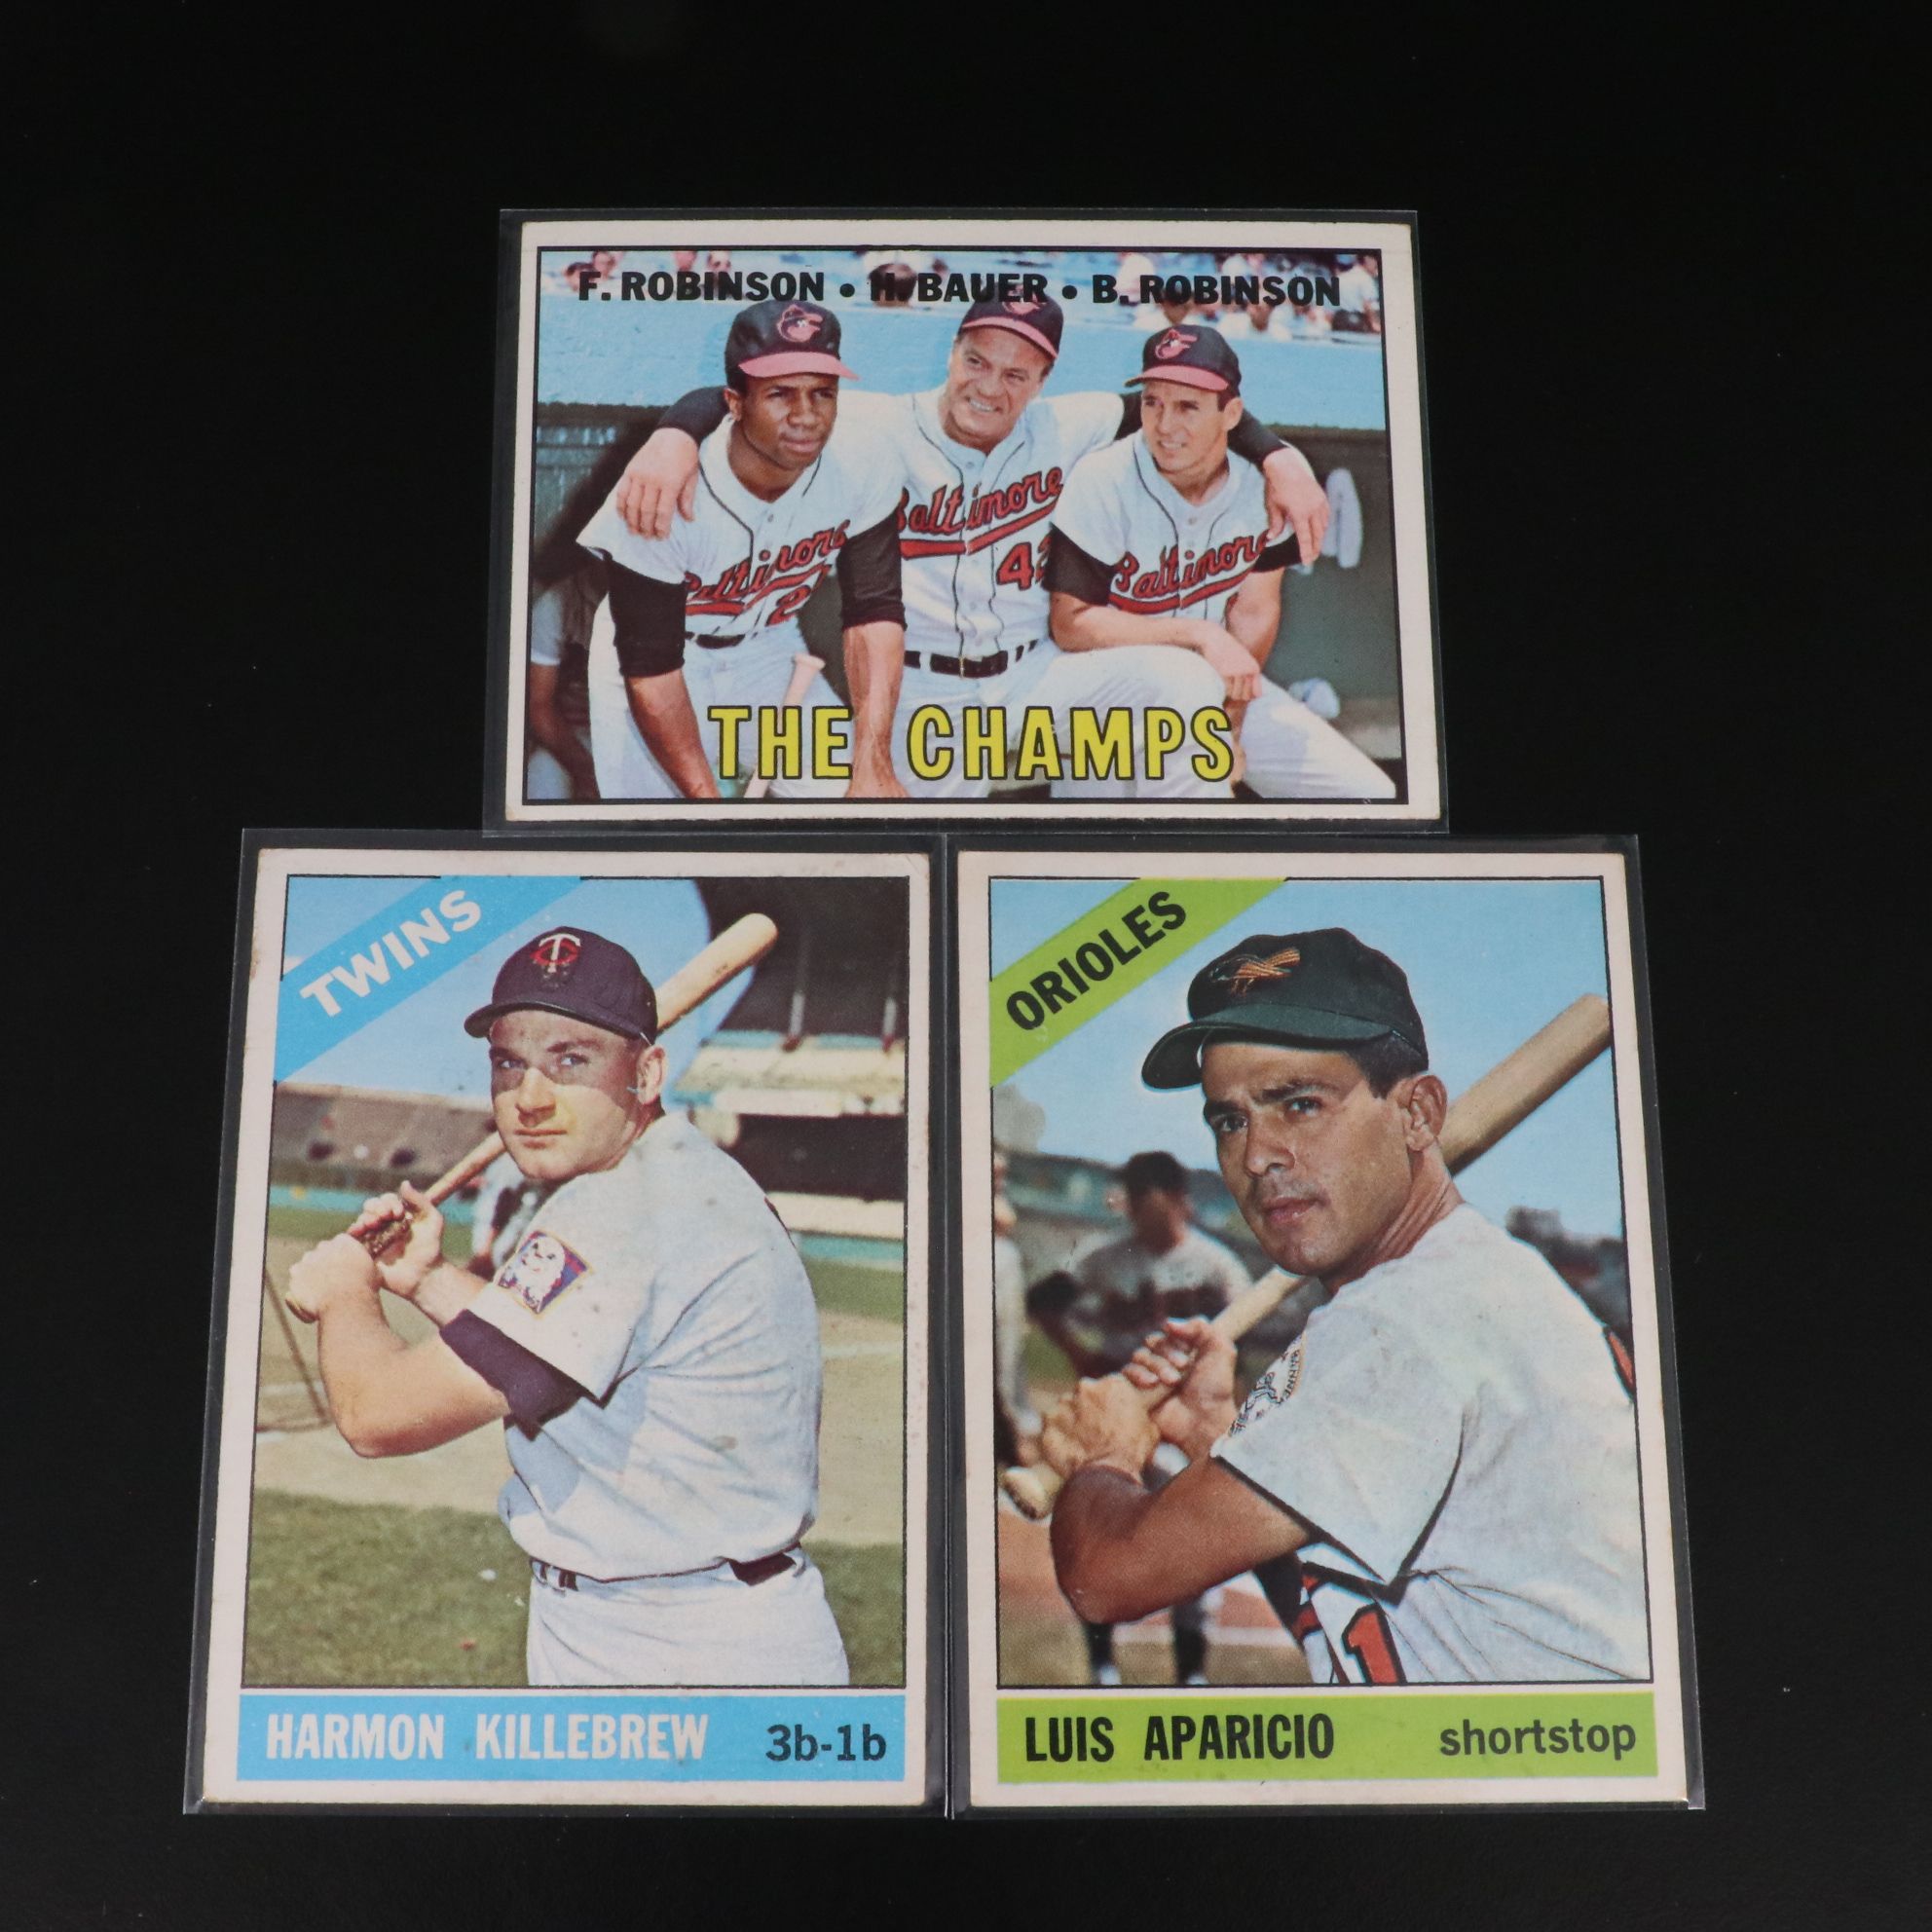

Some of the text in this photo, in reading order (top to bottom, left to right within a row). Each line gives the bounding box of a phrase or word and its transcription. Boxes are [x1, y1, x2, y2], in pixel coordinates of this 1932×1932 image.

[578, 272, 612, 302] F.
[621, 271, 824, 302] ROBINSON
[917, 273, 1049, 304] BAUER
[1093, 274, 1130, 305] B.
[1140, 274, 1341, 307] ROBINSON
[707, 703, 1235, 782] THE CHAMPS
[300, 889, 483, 1018] TWINS
[1006, 890, 1188, 1030] ORIOLES
[266, 1713, 709, 1761] HARMON KILLEBREW
[765, 1723, 887, 1764] 3b-1b
[1024, 1712, 1335, 1764] LUIS APARICIO
[1439, 1717, 1637, 1762] shortstop
